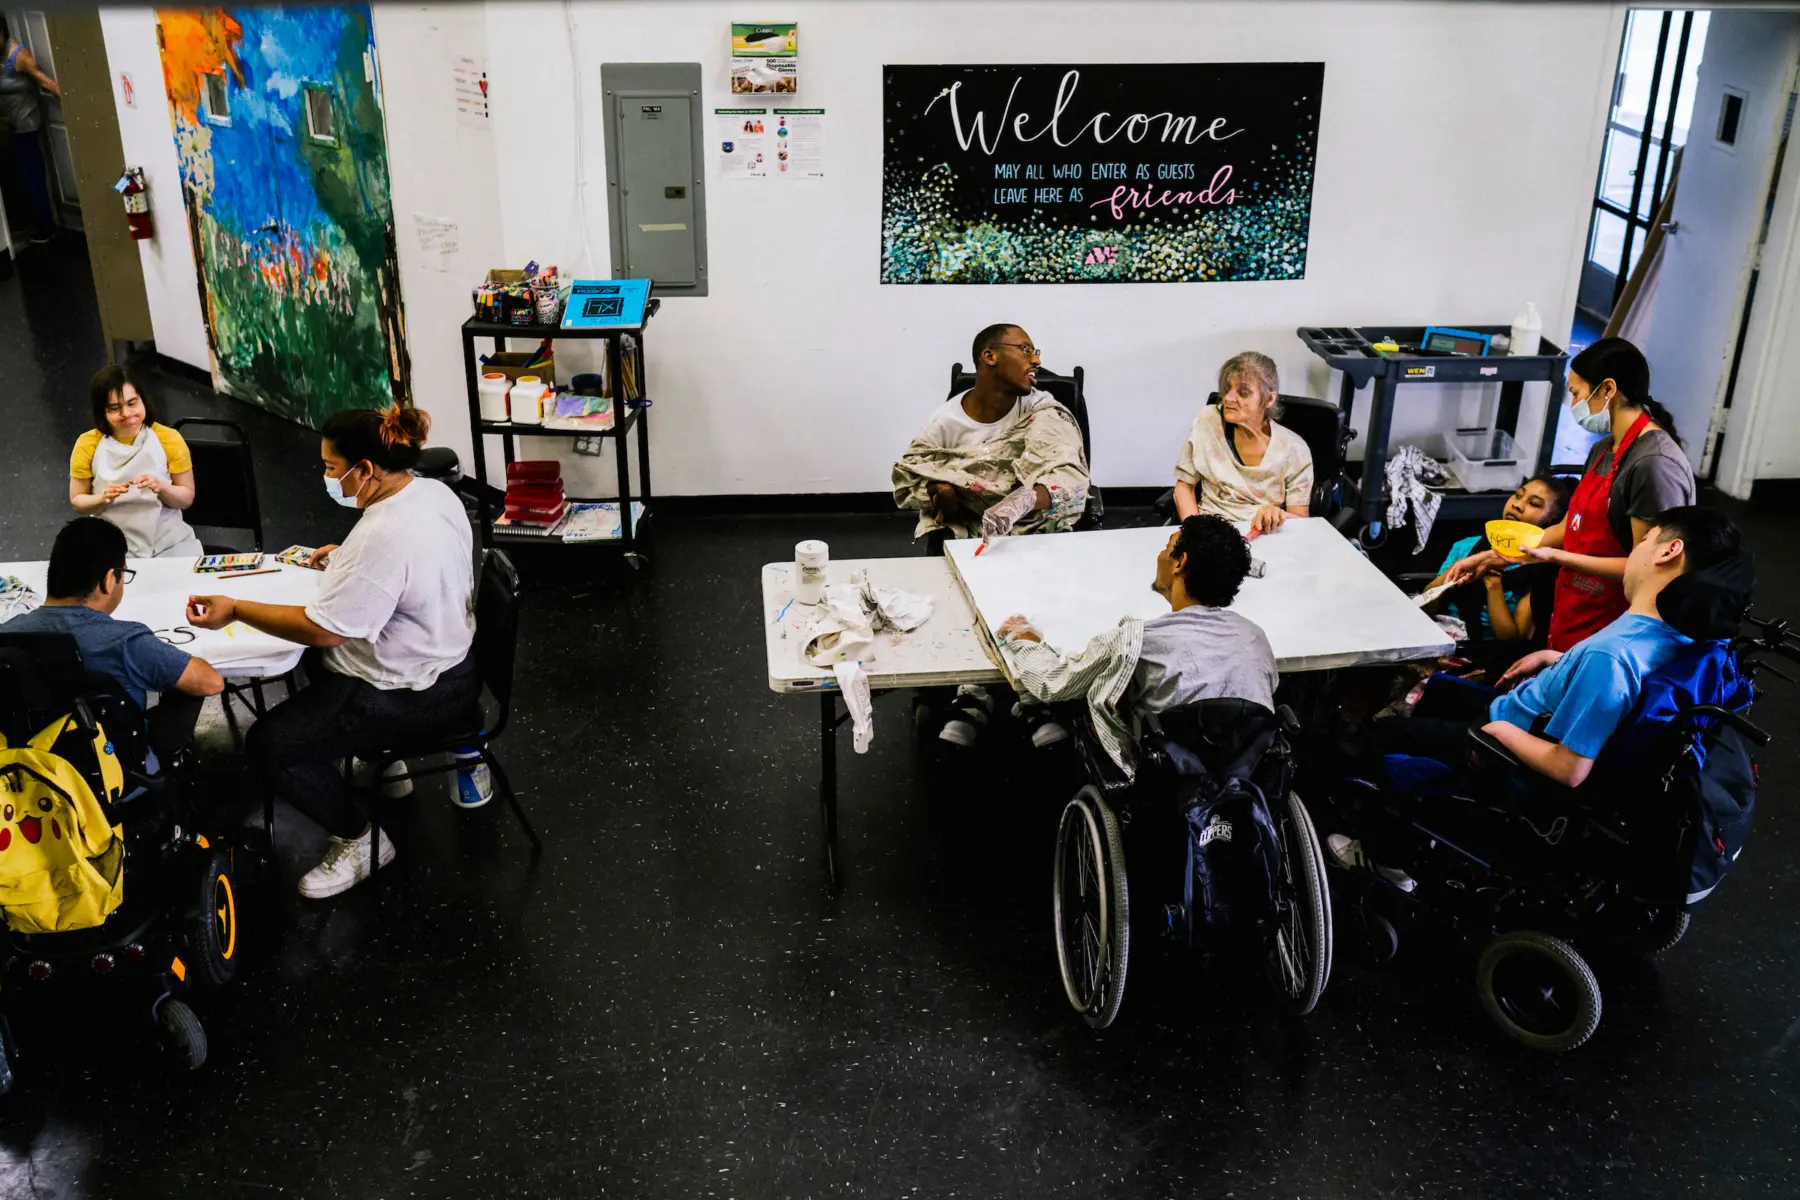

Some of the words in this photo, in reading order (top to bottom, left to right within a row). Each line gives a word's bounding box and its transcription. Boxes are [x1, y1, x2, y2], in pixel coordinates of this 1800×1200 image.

[924, 70, 1246, 155] Welcome
[994, 163, 1021, 179] MAY
[1025, 164, 1045, 180] ALL
[1052, 163, 1083, 179] WHO
[1091, 163, 1128, 180] ENTER
[1135, 163, 1151, 180] AS
[1157, 163, 1196, 180] GUESTS
[994, 188, 1028, 205] LEAVE
[1034, 187, 1063, 203] HERE
[1069, 187, 1084, 203] AS
[1090, 164, 1244, 220] friends
[591, 301, 616, 314] XL
[1407, 366, 1426, 375] WEN
[1490, 531, 1516, 549] ART
